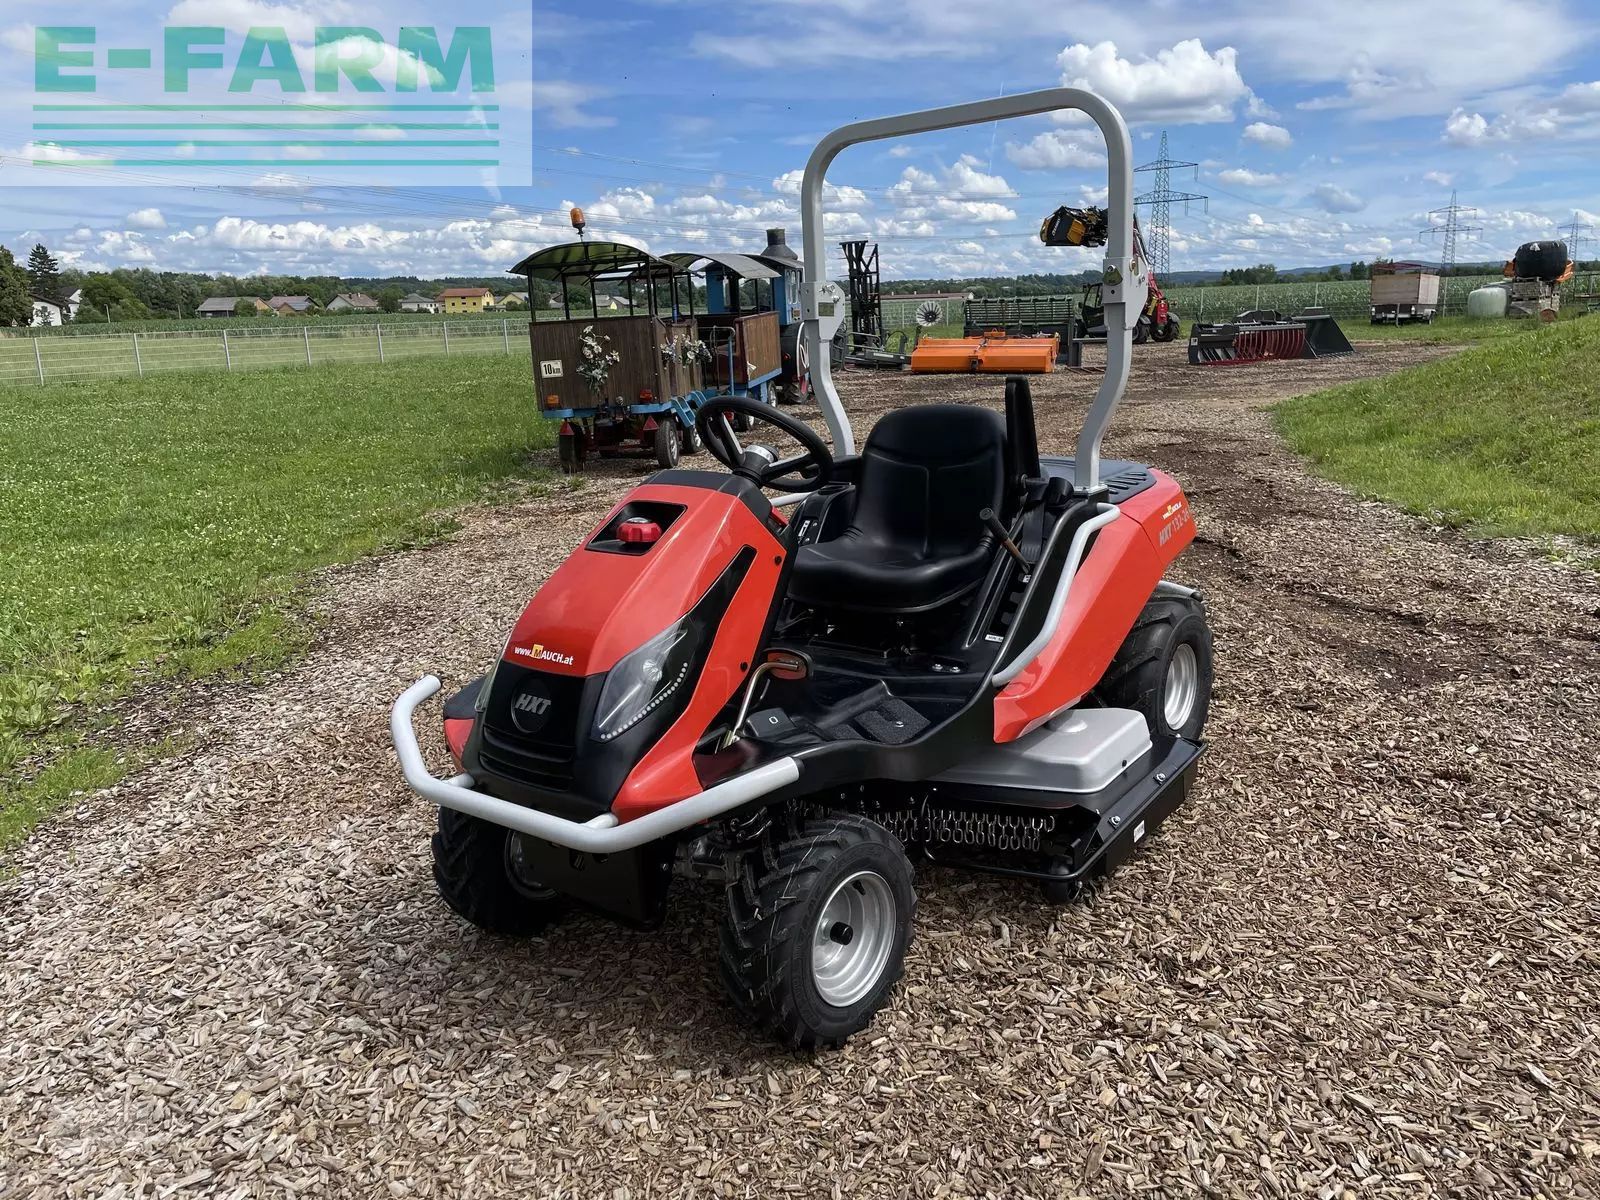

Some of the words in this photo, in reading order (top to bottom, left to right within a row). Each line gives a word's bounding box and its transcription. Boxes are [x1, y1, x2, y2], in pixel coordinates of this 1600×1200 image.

[543, 364, 552, 374] 10
[514, 643, 574, 666] www.MAUCH.at
[515, 693, 552, 715] HXT
